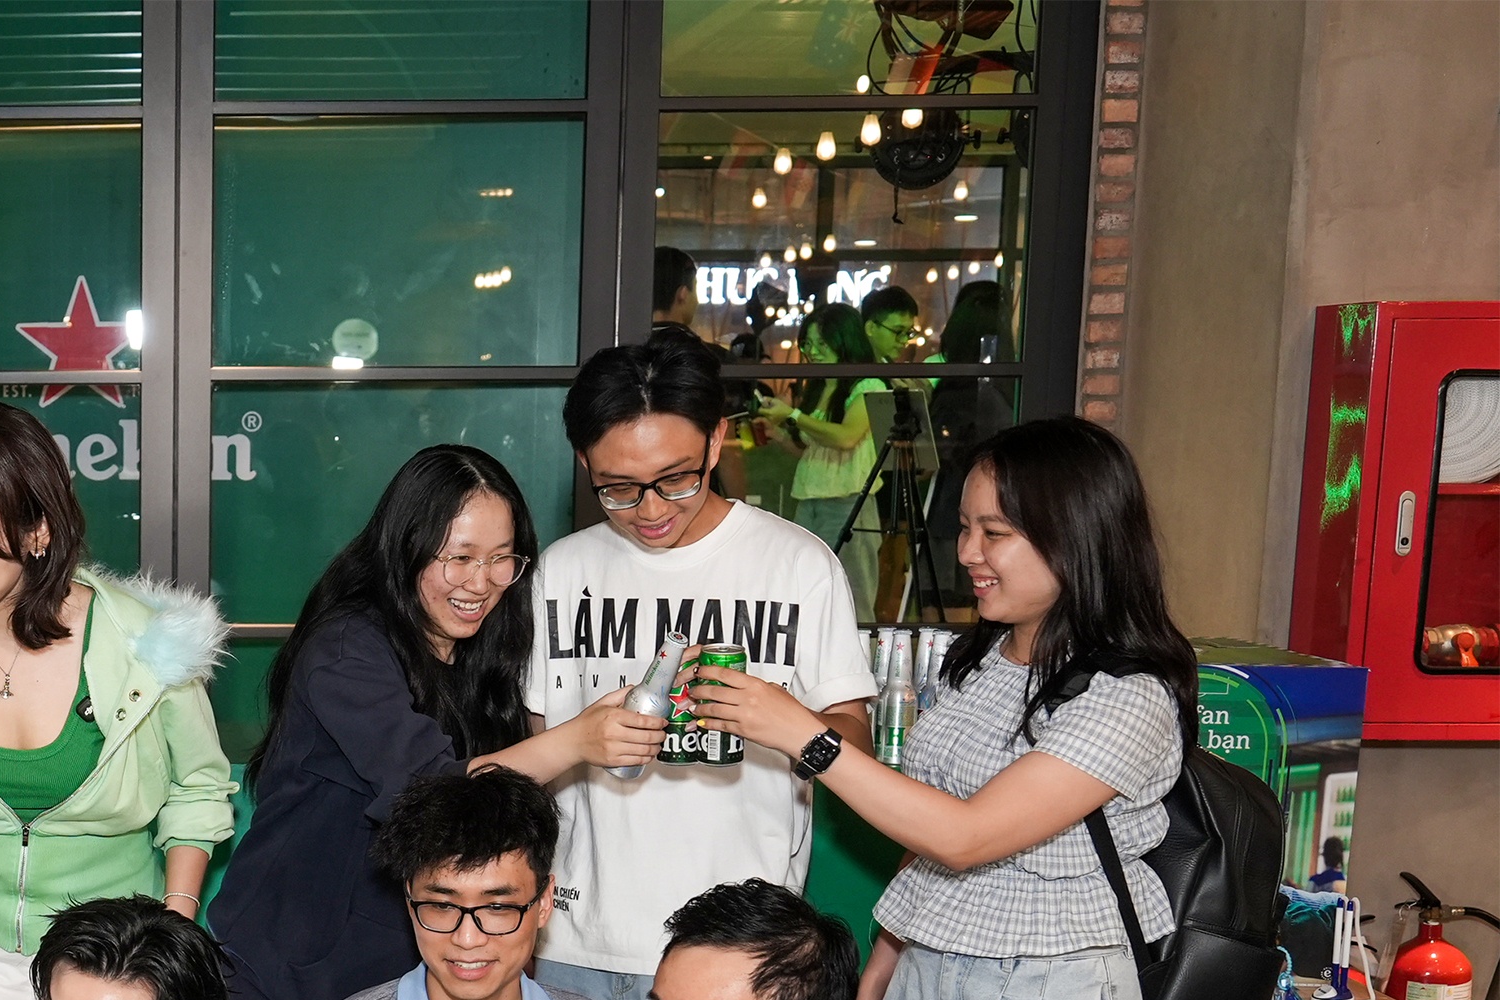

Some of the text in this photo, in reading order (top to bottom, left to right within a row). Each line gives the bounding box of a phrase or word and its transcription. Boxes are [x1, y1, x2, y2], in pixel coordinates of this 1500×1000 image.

[3, 385, 32, 398] EST.
[546, 586, 640, 660] LÀM
[1207, 730, 1251, 754] bạn
